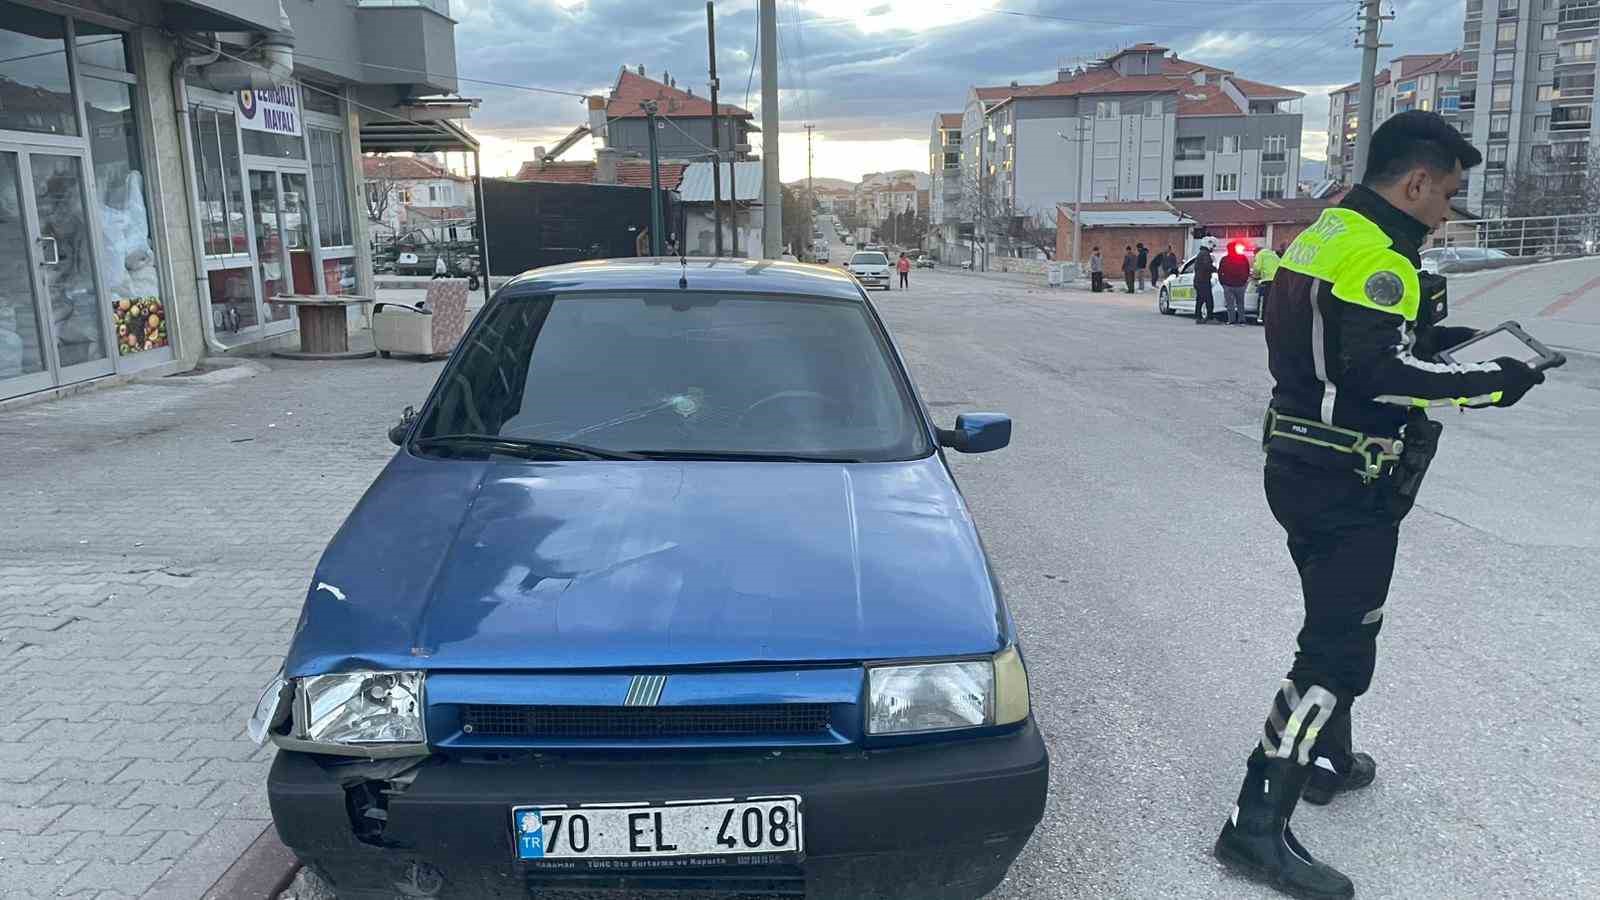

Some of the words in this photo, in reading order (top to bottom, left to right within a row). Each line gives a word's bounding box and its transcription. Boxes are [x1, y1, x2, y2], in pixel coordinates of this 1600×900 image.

[264, 108, 295, 132] MAYALI
[542, 814, 589, 853] 70
[628, 811, 677, 852] EL
[717, 805, 789, 848] 408
[522, 837, 540, 848] TR
